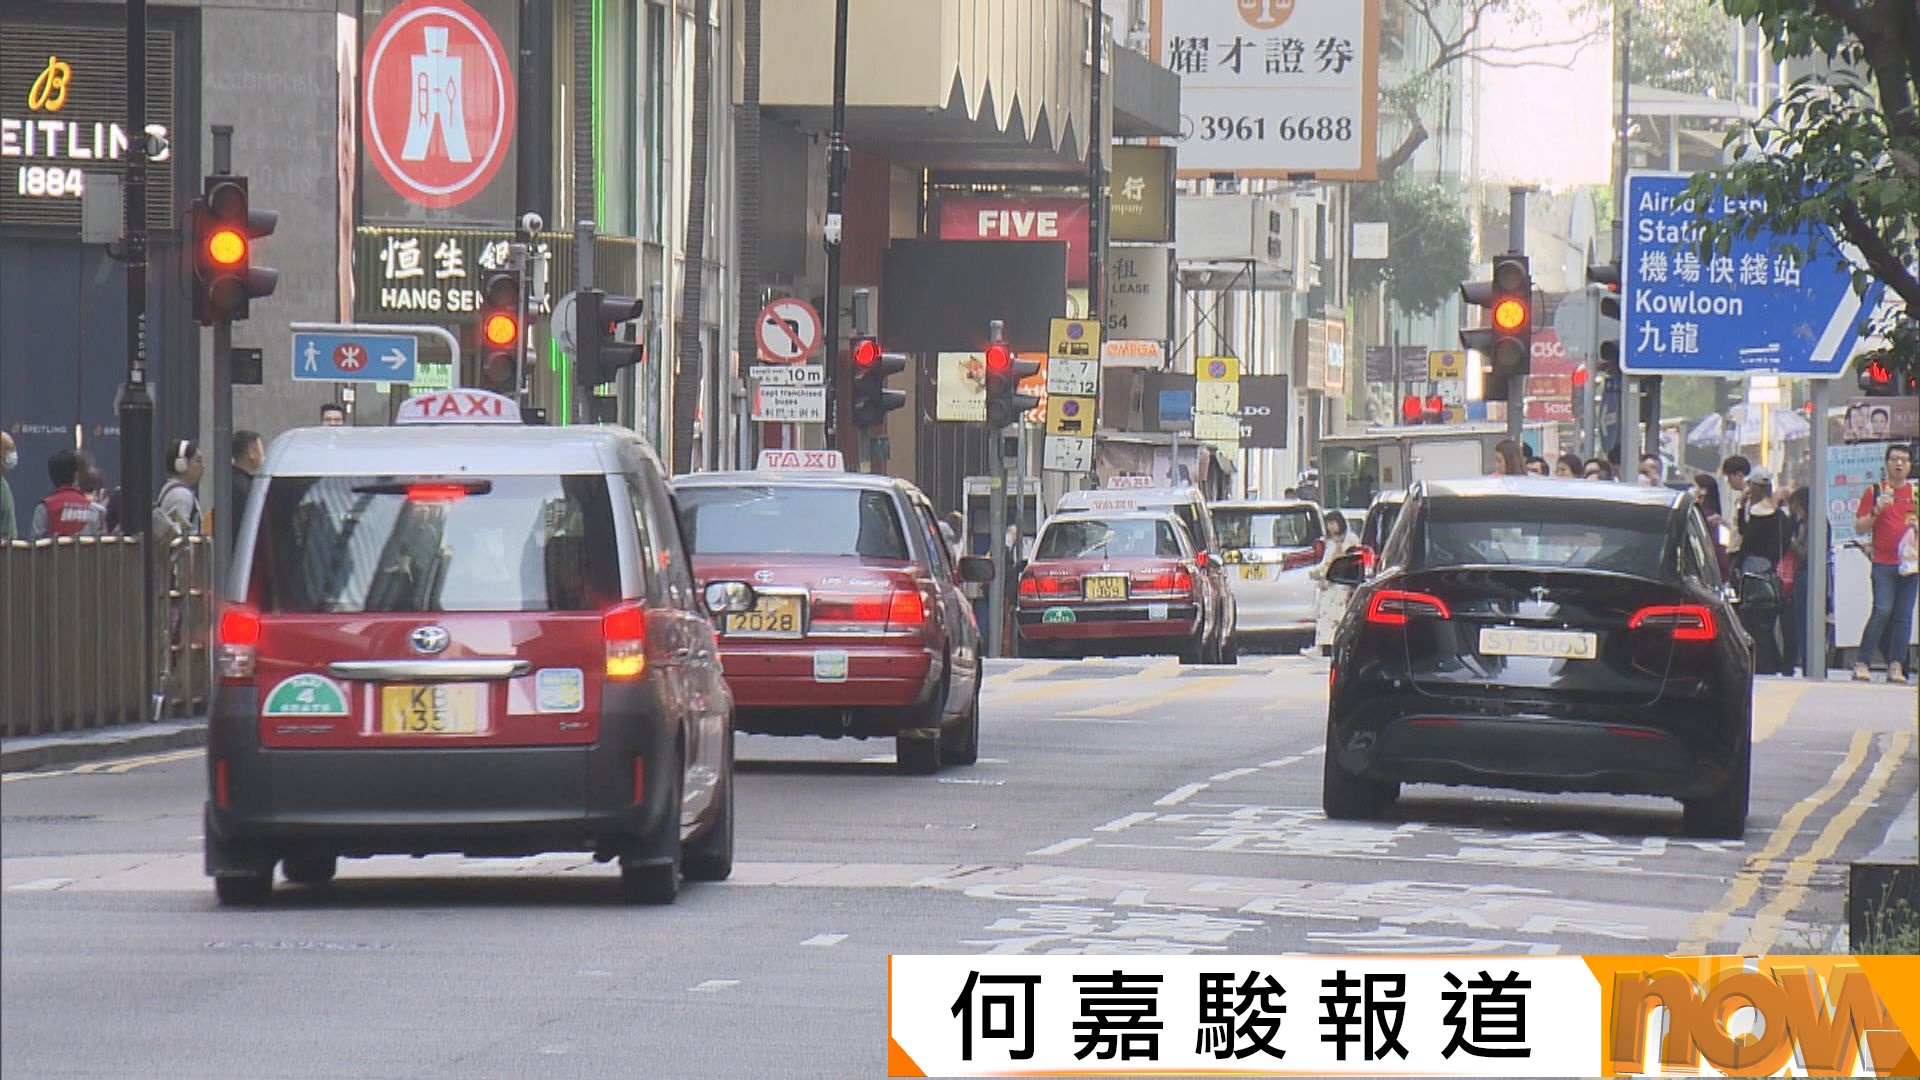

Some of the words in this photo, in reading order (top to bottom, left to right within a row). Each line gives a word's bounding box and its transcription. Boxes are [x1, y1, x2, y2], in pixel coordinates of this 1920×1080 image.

[1168, 36, 1354, 74] 耀才證券
[1200, 116, 1265, 141] 3961
[1279, 116, 1352, 141] 6688
[18, 166, 83, 197] 1884
[1121, 176, 1146, 201] 行
[978, 210, 1058, 237] FIVE
[1112, 284, 1150, 294] LEASE
[381, 288, 442, 310] HANG
[447, 290, 484, 312] SEN
[1635, 289, 1743, 315] Kowloon
[1108, 315, 1128, 330] 54
[1637, 320, 1699, 353] 九龍
[788, 368, 805, 381] 10
[808, 371, 820, 381] m
[1080, 362, 1088, 374] 7
[1080, 382, 1094, 393] 12
[415, 394, 502, 416] TAXI
[1075, 440, 1083, 451] 7
[764, 453, 837, 468] TAXI
[1074, 458, 1083, 469] 7
[1112, 478, 1150, 487] TAXI
[1093, 500, 1133, 509] TAXI
[734, 614, 794, 631] 2028
[1487, 632, 1515, 651] SY
[1525, 633, 1589, 655] 5063
[295, 688, 314, 703] 4
